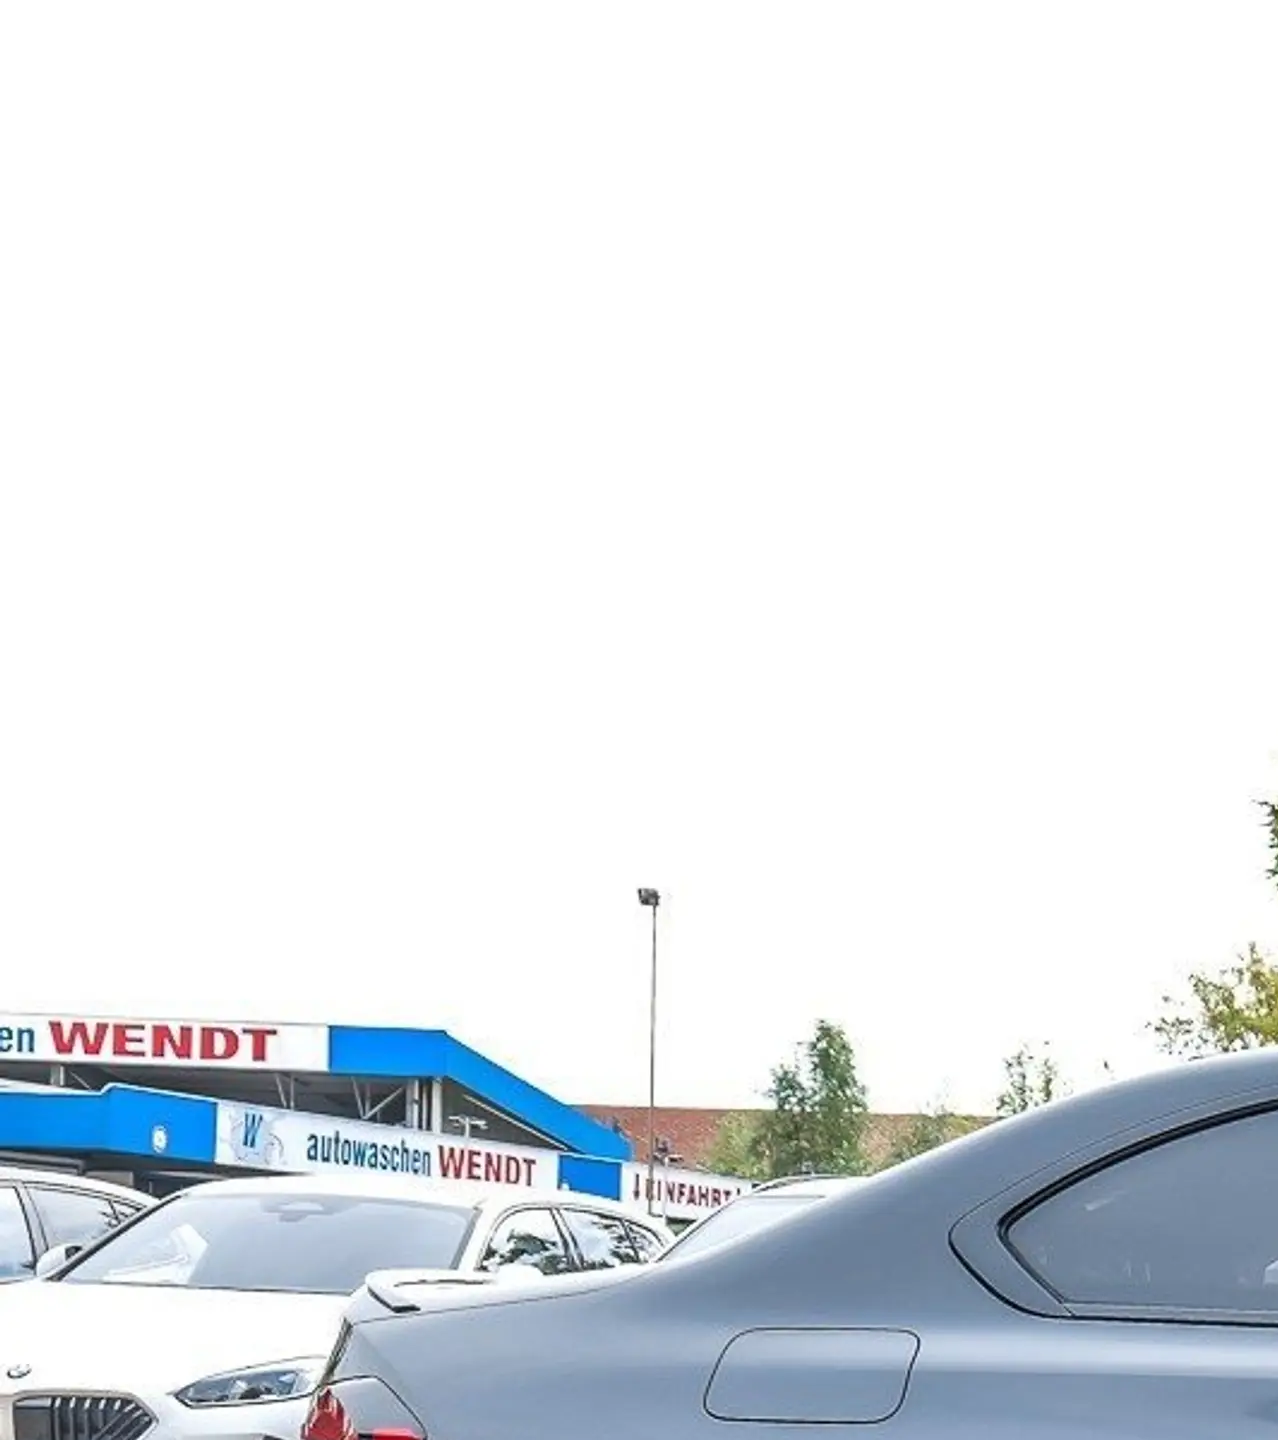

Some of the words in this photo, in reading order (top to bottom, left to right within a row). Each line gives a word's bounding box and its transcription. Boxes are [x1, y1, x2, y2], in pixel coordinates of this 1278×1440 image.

[48, 1020, 278, 1062] WENDT
[306, 1130, 432, 1177] autowaschen
[437, 1144, 537, 1188] WENDT
